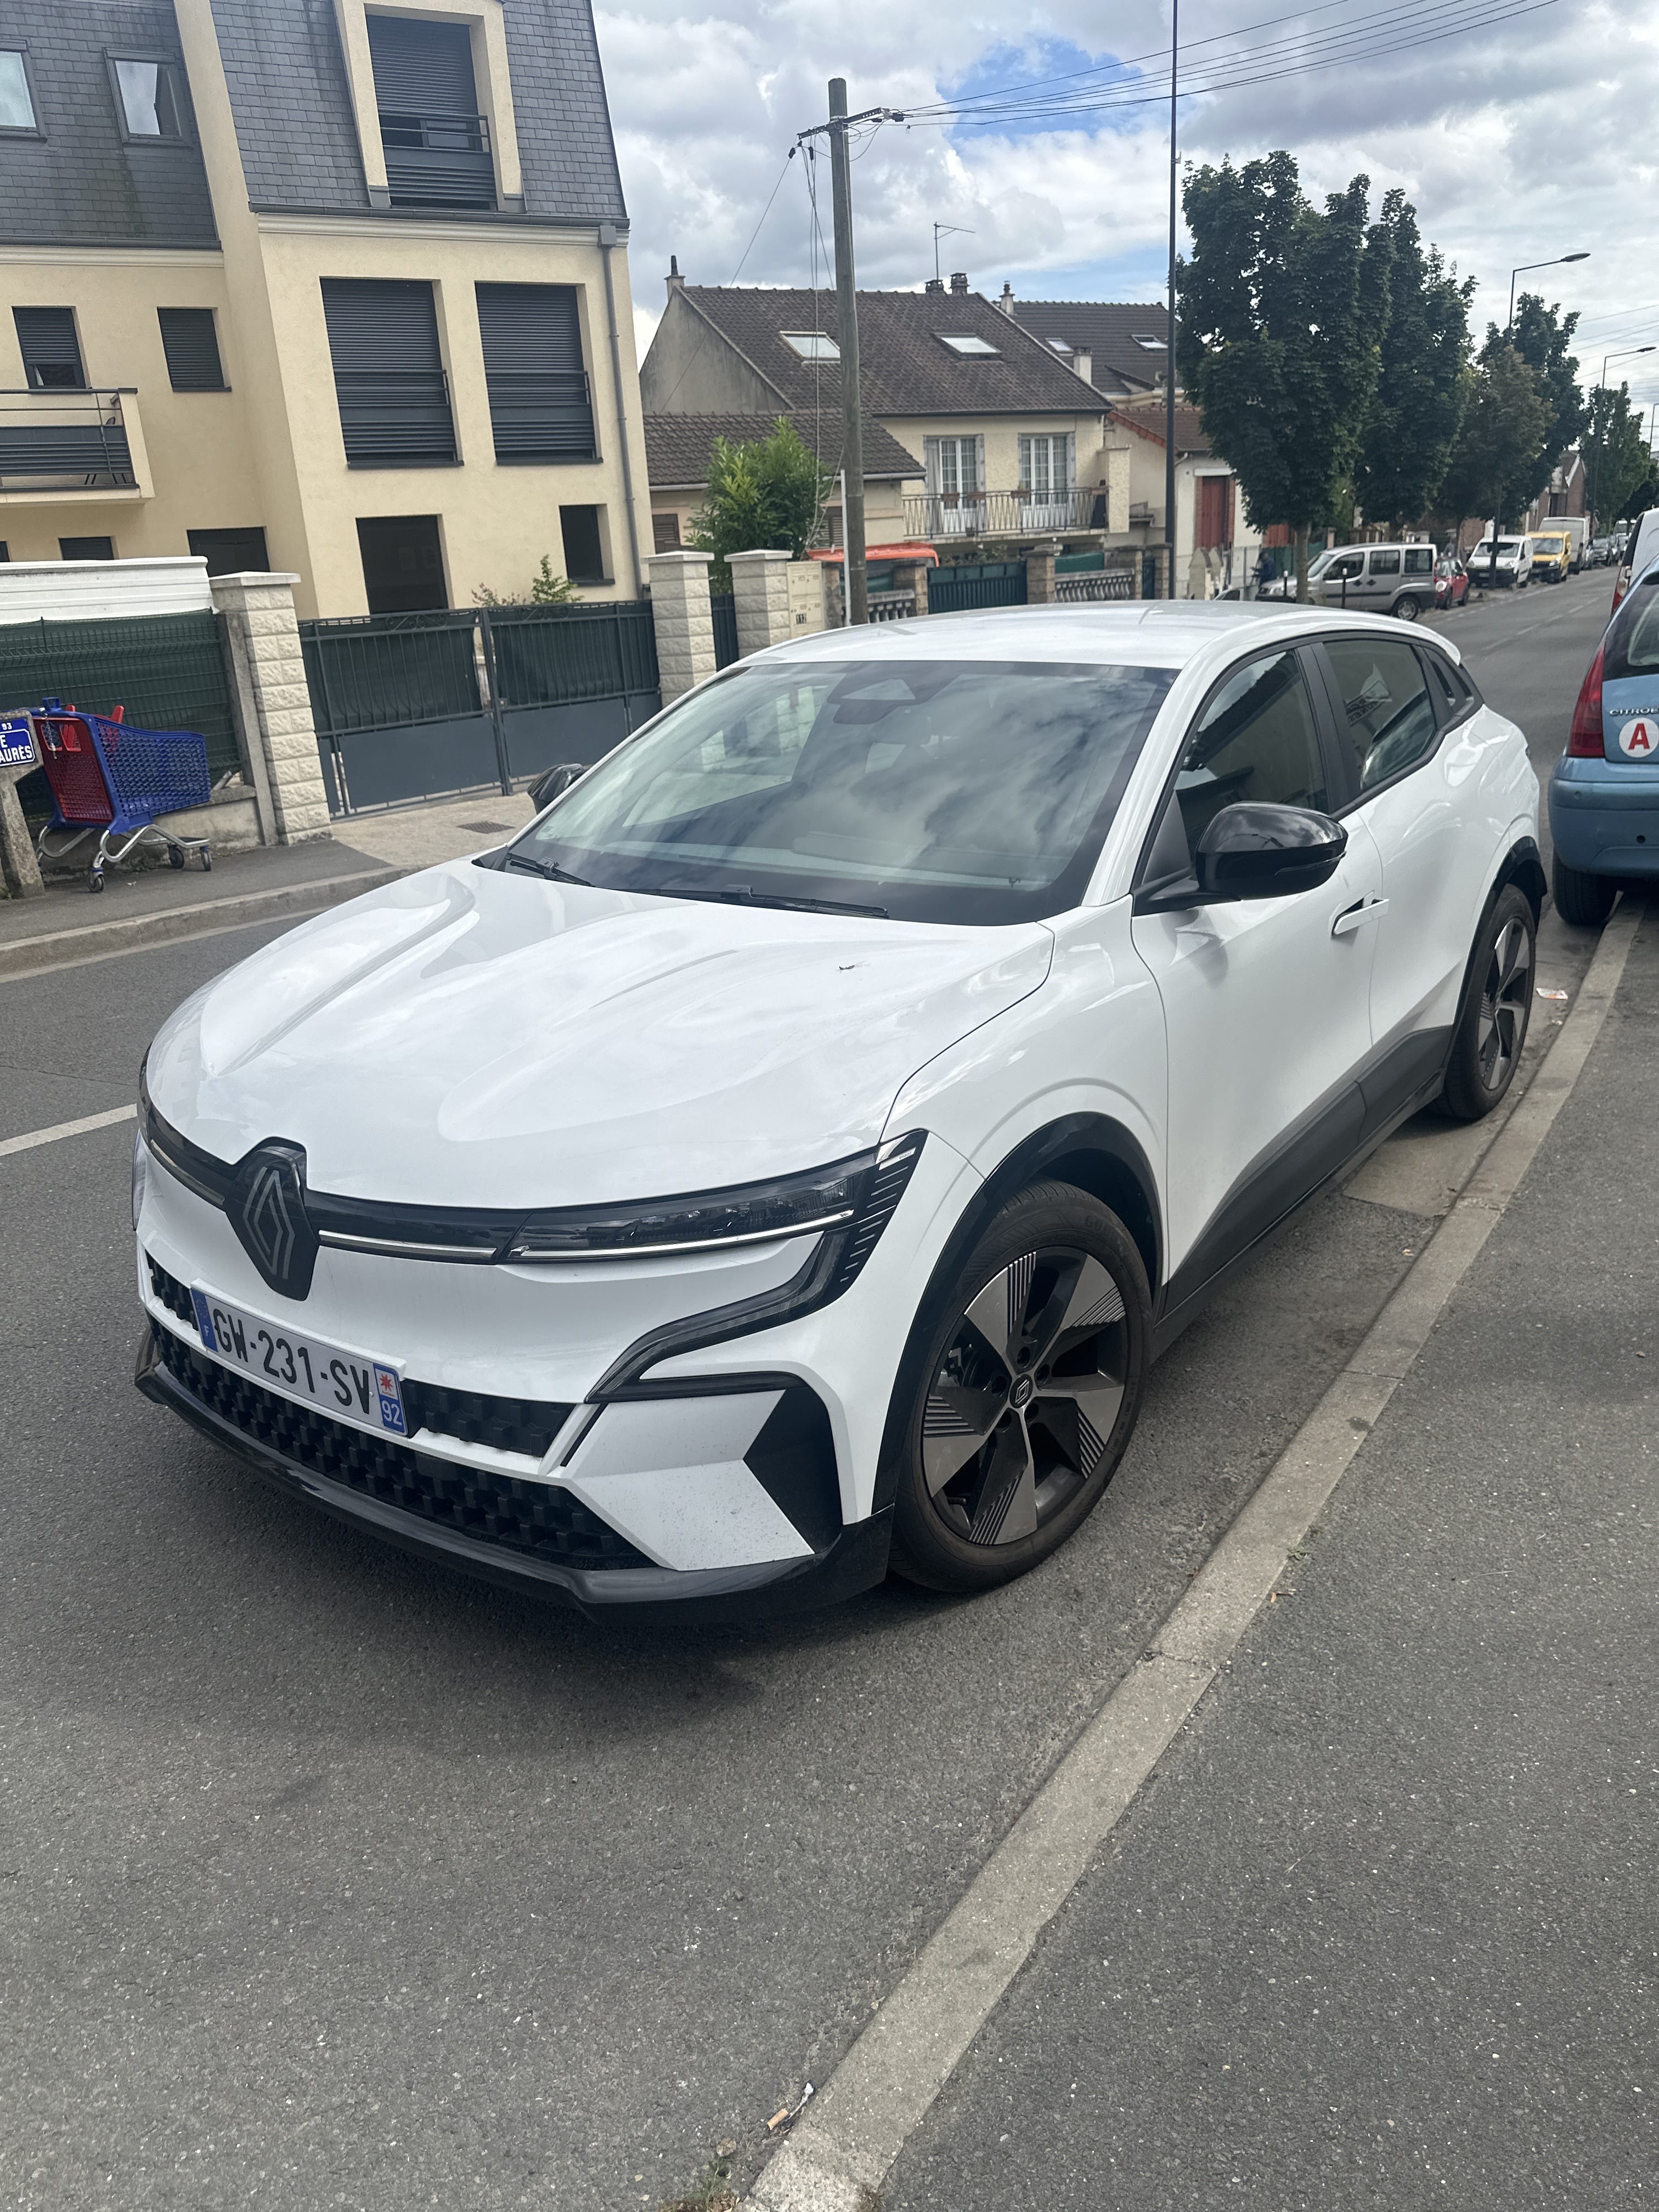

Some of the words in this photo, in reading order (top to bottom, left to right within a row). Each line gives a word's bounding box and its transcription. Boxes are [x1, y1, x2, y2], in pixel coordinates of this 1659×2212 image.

[1628, 723, 1650, 750] A
[204, 1324, 209, 1337] F
[213, 1308, 370, 1415] GW-231-SV
[382, 1400, 402, 1426] 92
